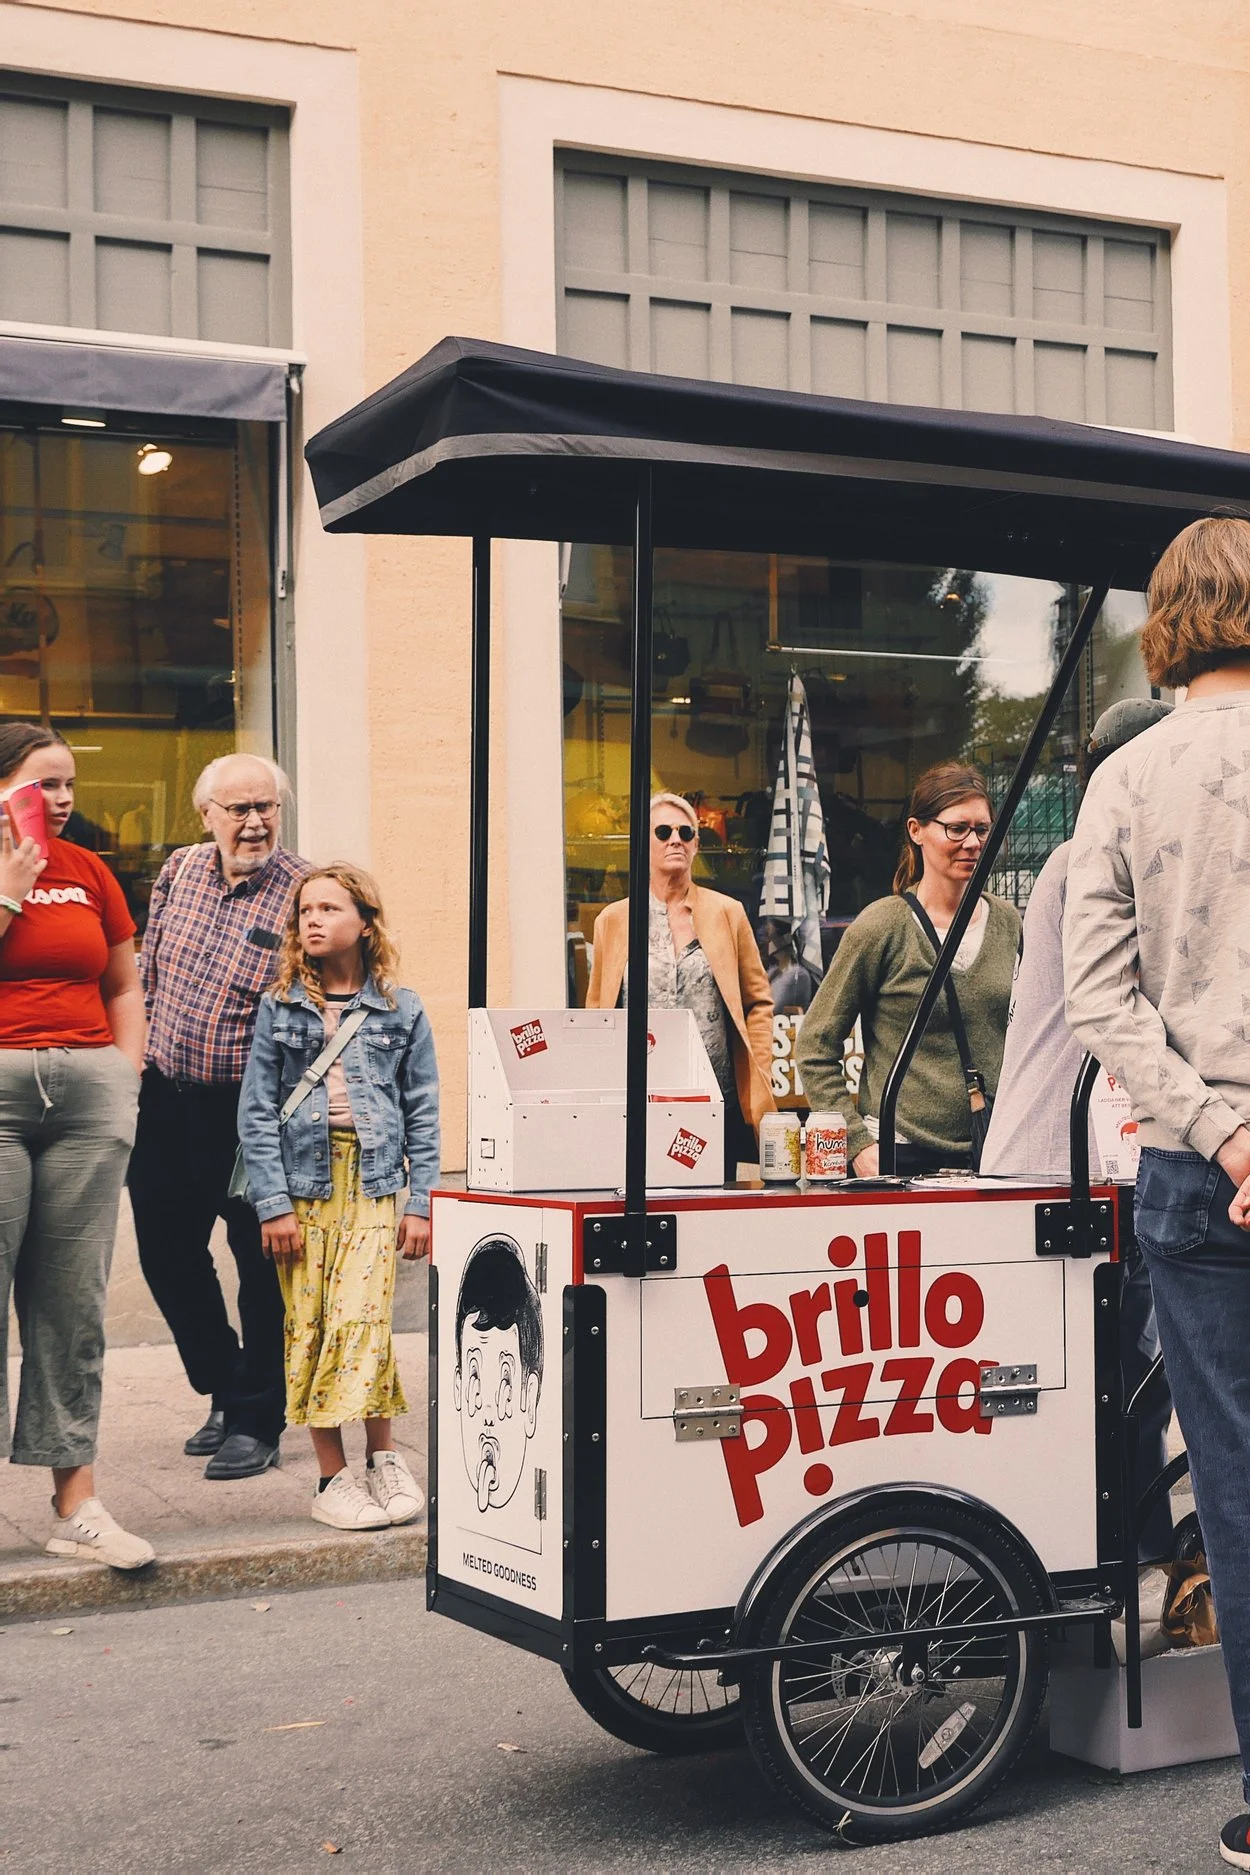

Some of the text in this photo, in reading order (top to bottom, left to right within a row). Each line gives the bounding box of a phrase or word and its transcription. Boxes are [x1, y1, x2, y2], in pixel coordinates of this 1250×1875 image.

[512, 1023, 541, 1044] brillo
[675, 1131, 702, 1152] brillo
[703, 1230, 985, 1388] brillo
[719, 1356, 1000, 1527] pizza
[462, 1552, 537, 1591] MELTED GOODNESS
